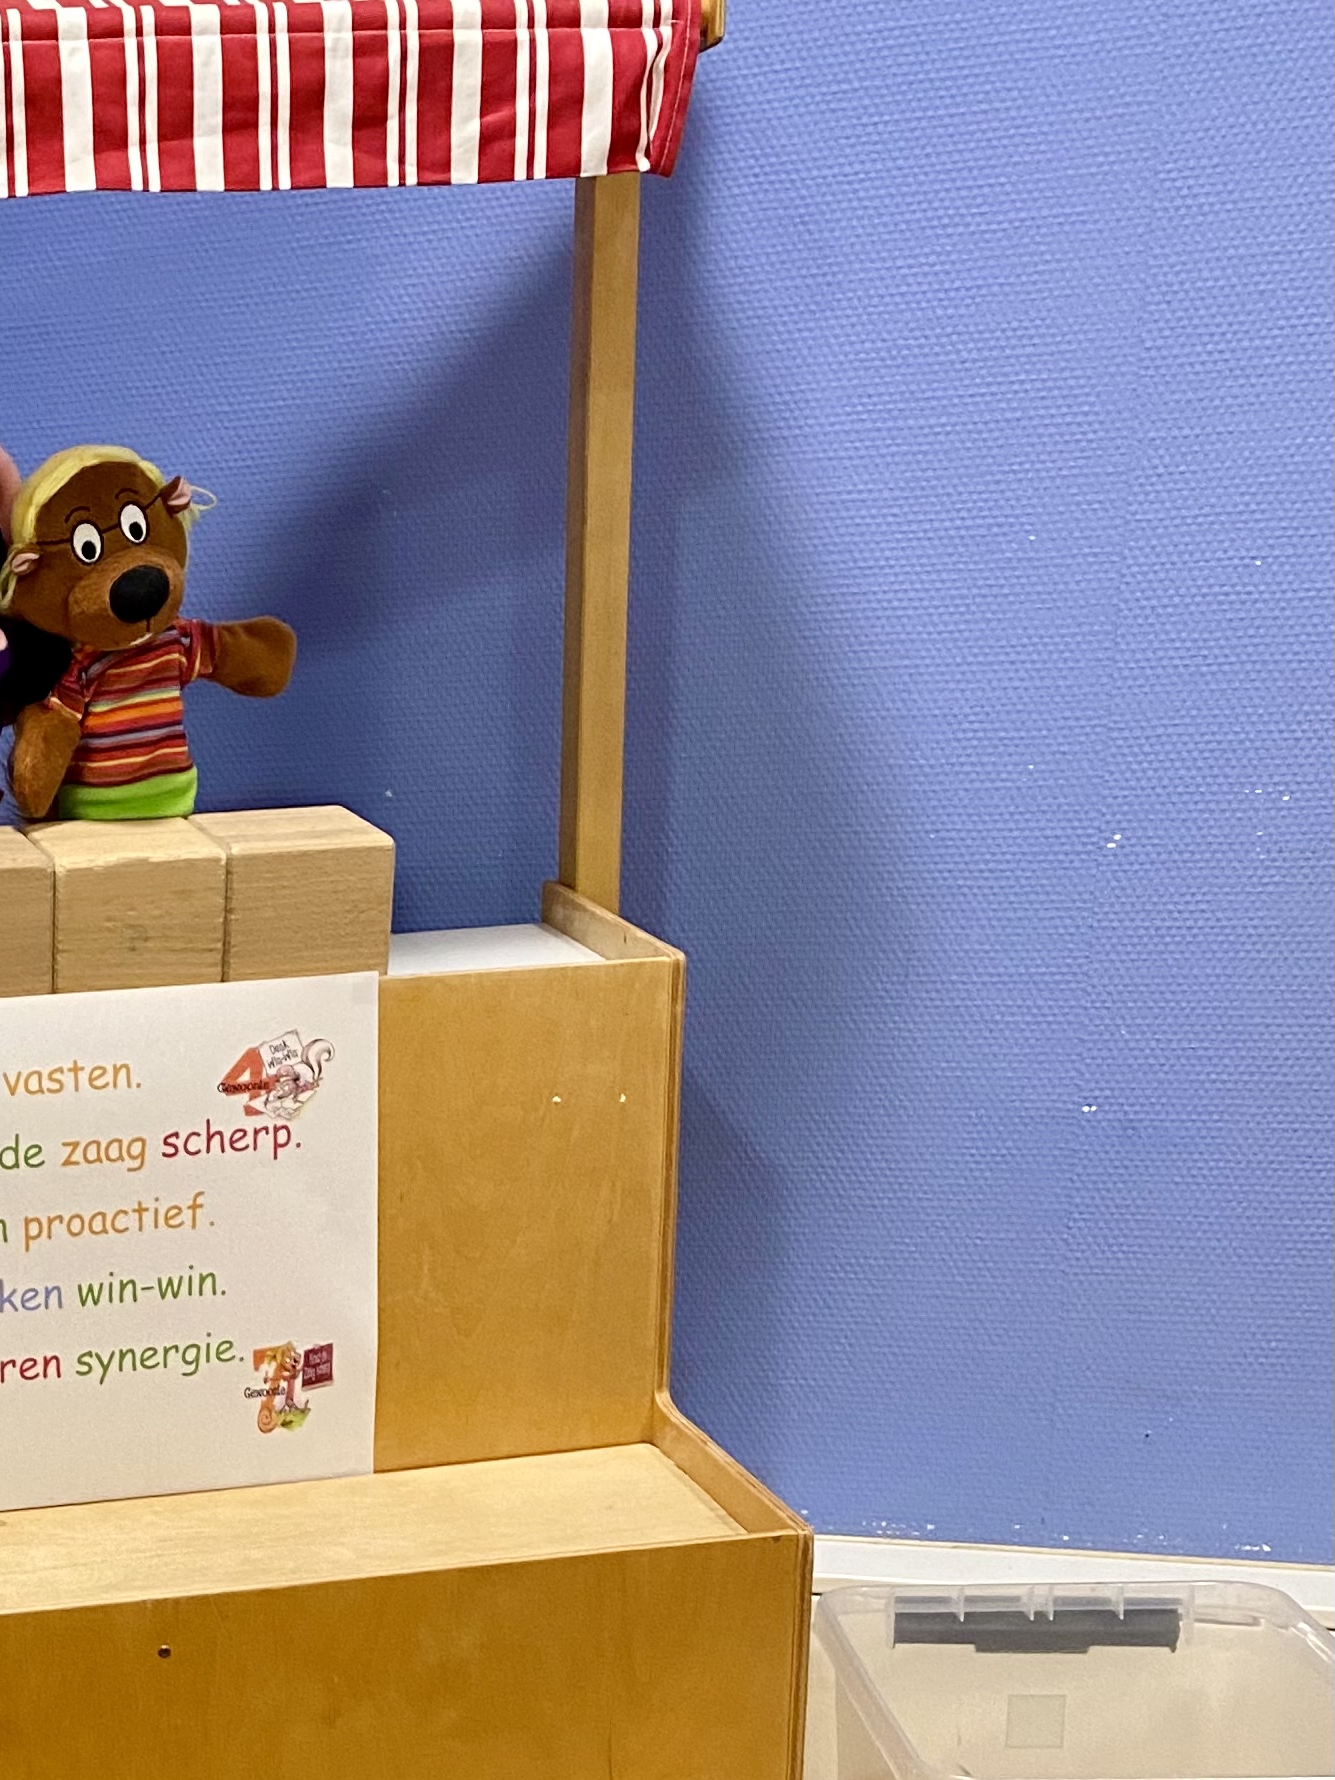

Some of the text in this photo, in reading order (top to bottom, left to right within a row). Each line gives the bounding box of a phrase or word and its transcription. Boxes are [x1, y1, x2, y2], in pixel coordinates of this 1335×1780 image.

[3, 1060, 142, 1095] vasten.
[61, 1135, 147, 1172] zaag
[161, 1119, 302, 1162] scherp.
[23, 1191, 215, 1252] proactief.
[77, 1264, 227, 1307] win-win.
[75, 1332, 245, 1385] synergie.
